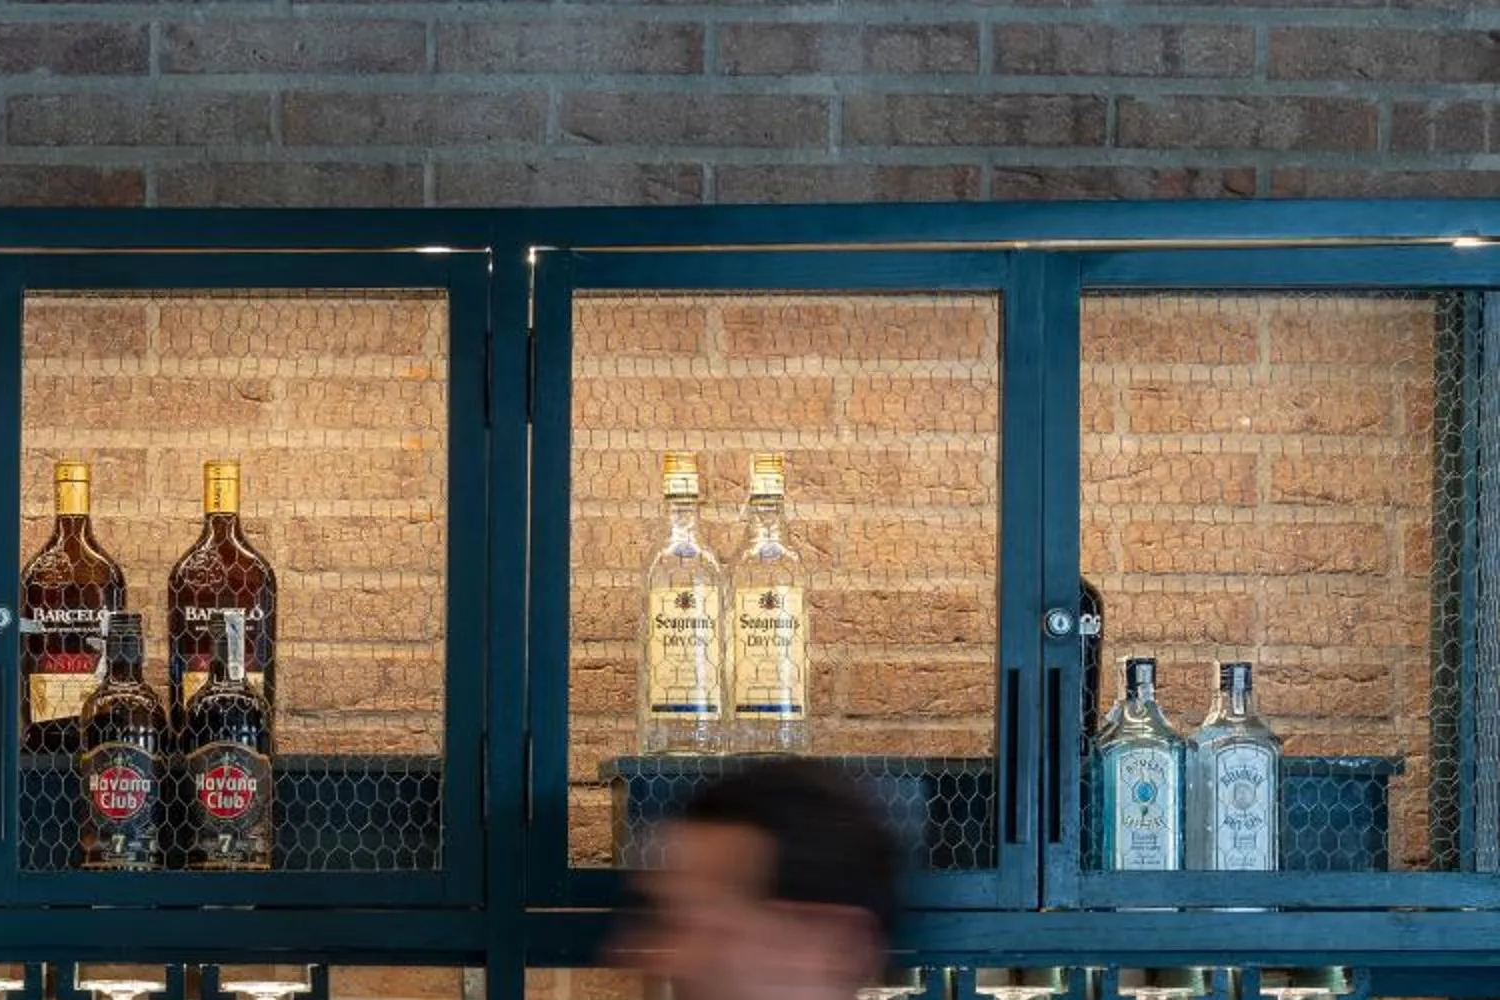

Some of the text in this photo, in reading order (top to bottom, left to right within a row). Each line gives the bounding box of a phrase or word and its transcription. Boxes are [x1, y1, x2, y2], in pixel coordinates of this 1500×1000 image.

[655, 613, 714, 632] Seagram's
[740, 613, 800, 632] Seagram's
[89, 773, 151, 792] Havana
[195, 773, 257, 791] Havana
[101, 791, 137, 809] Club
[207, 791, 245, 809] Club
[111, 834, 127, 853] 7
[219, 834, 233, 853] 7
